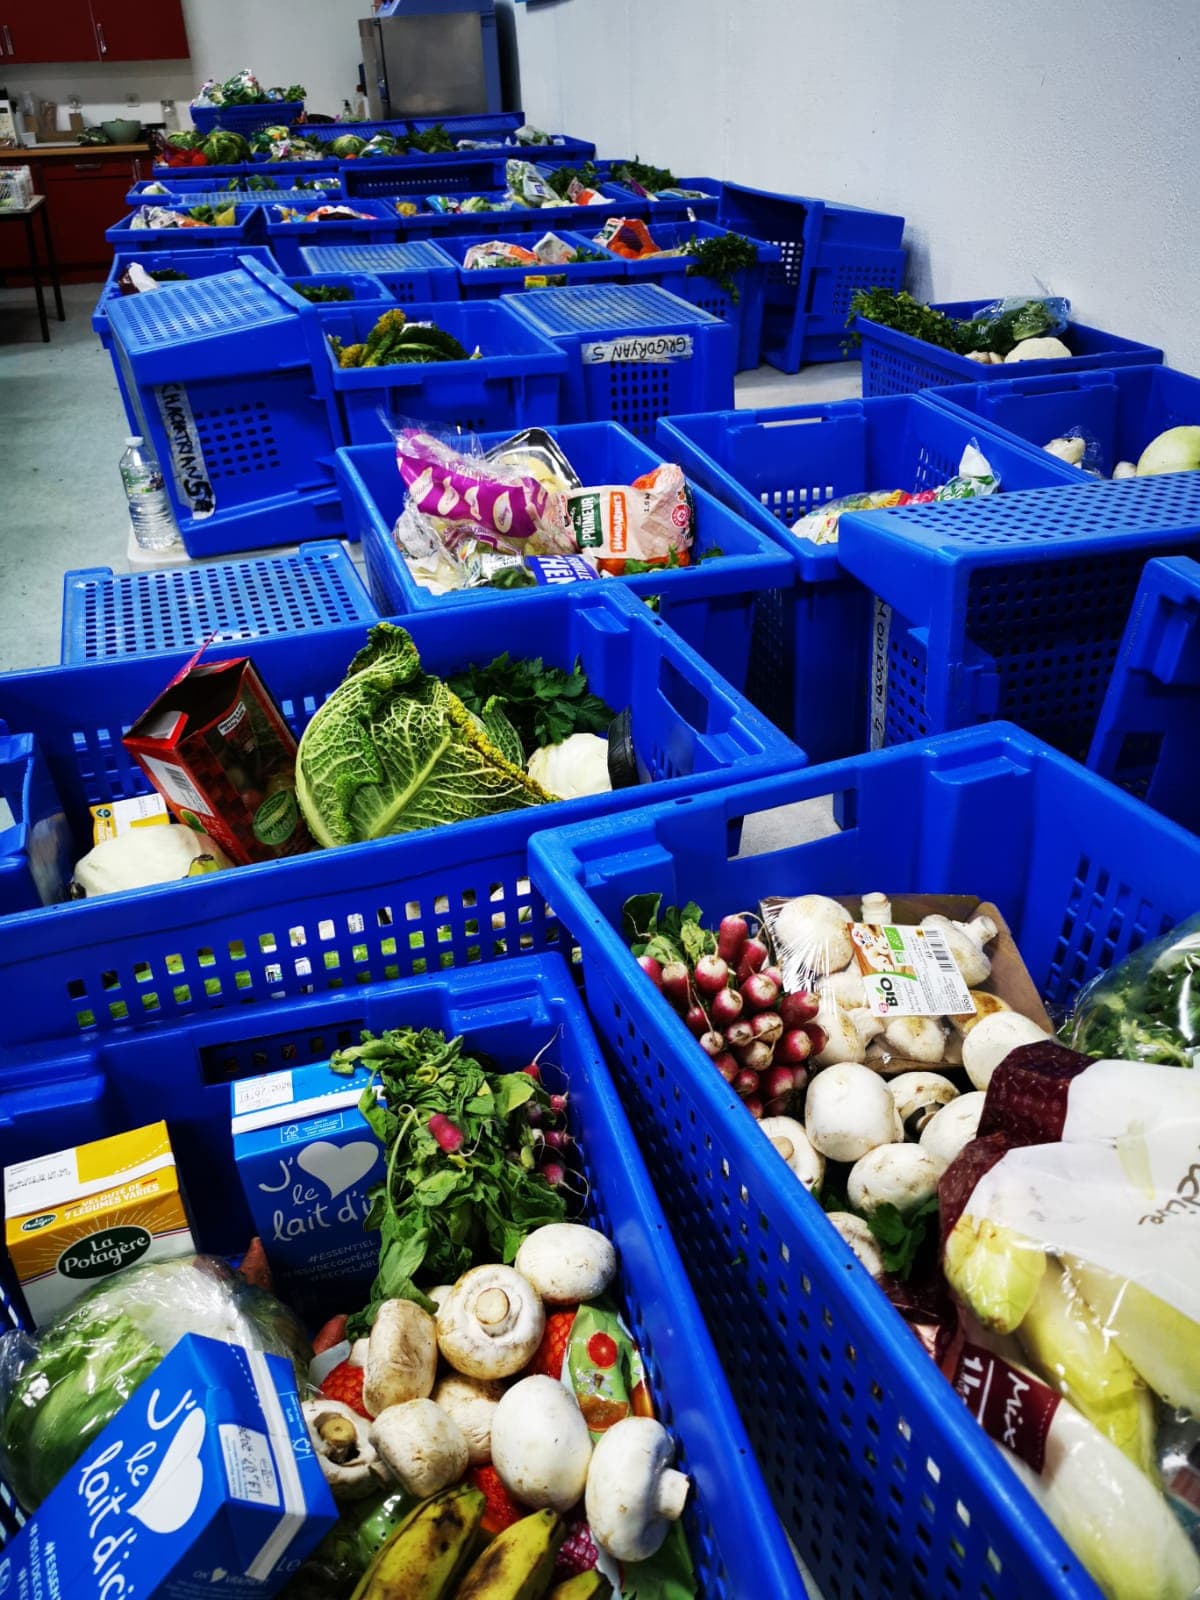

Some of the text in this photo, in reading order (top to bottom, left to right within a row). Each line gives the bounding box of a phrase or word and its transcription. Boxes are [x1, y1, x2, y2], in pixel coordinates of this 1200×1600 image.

[581, 496, 596, 541] PRIMEUR
[880, 977, 898, 1007] BIO
[258, 1156, 293, 1192] J'
[292, 1183, 319, 1206] le
[273, 1190, 371, 1241] lait d'i
[63, 1236, 149, 1273] Potagère
[90, 1238, 114, 1252] La
[147, 1388, 197, 1431] J'
[1003, 1372, 1030, 1448] Mix
[126, 1441, 157, 1487] le
[78, 1439, 129, 1539] lait
